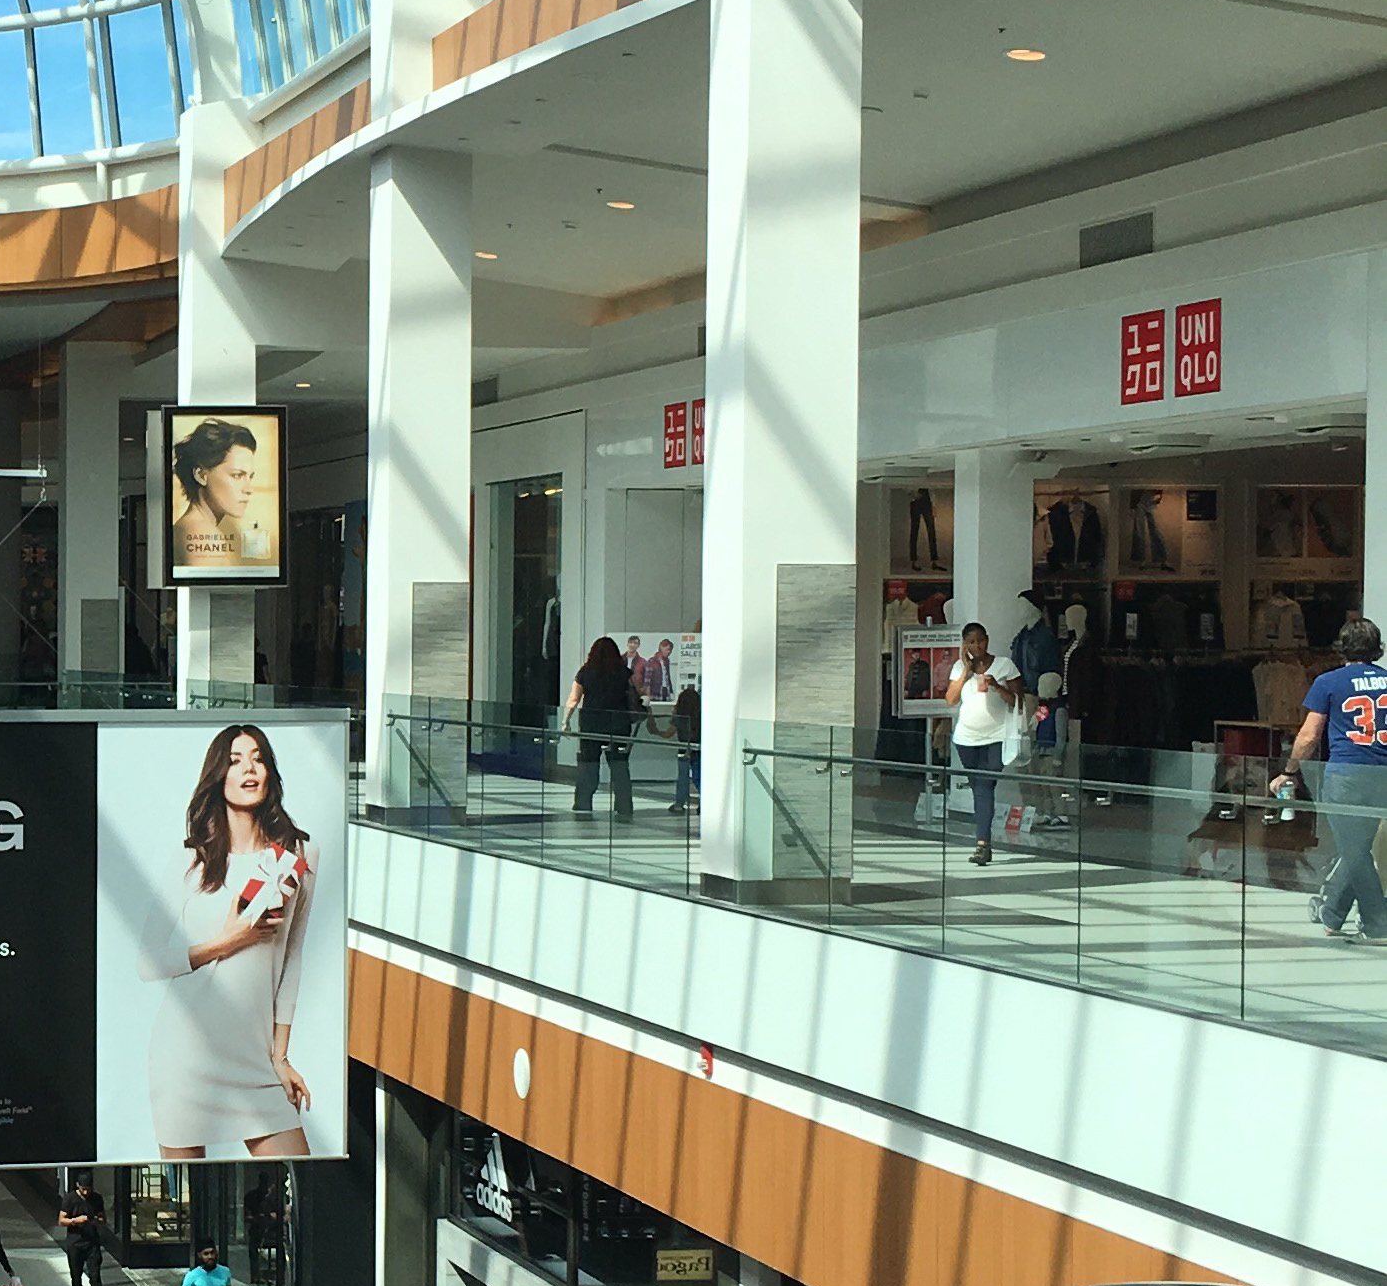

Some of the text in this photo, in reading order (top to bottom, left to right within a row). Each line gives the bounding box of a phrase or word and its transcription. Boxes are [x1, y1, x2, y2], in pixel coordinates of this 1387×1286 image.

[1180, 311, 1214, 347] UNI
[1180, 350, 1217, 392] QLO
[186, 544, 235, 553] CHANEL
[476, 1182, 513, 1223] adidas
